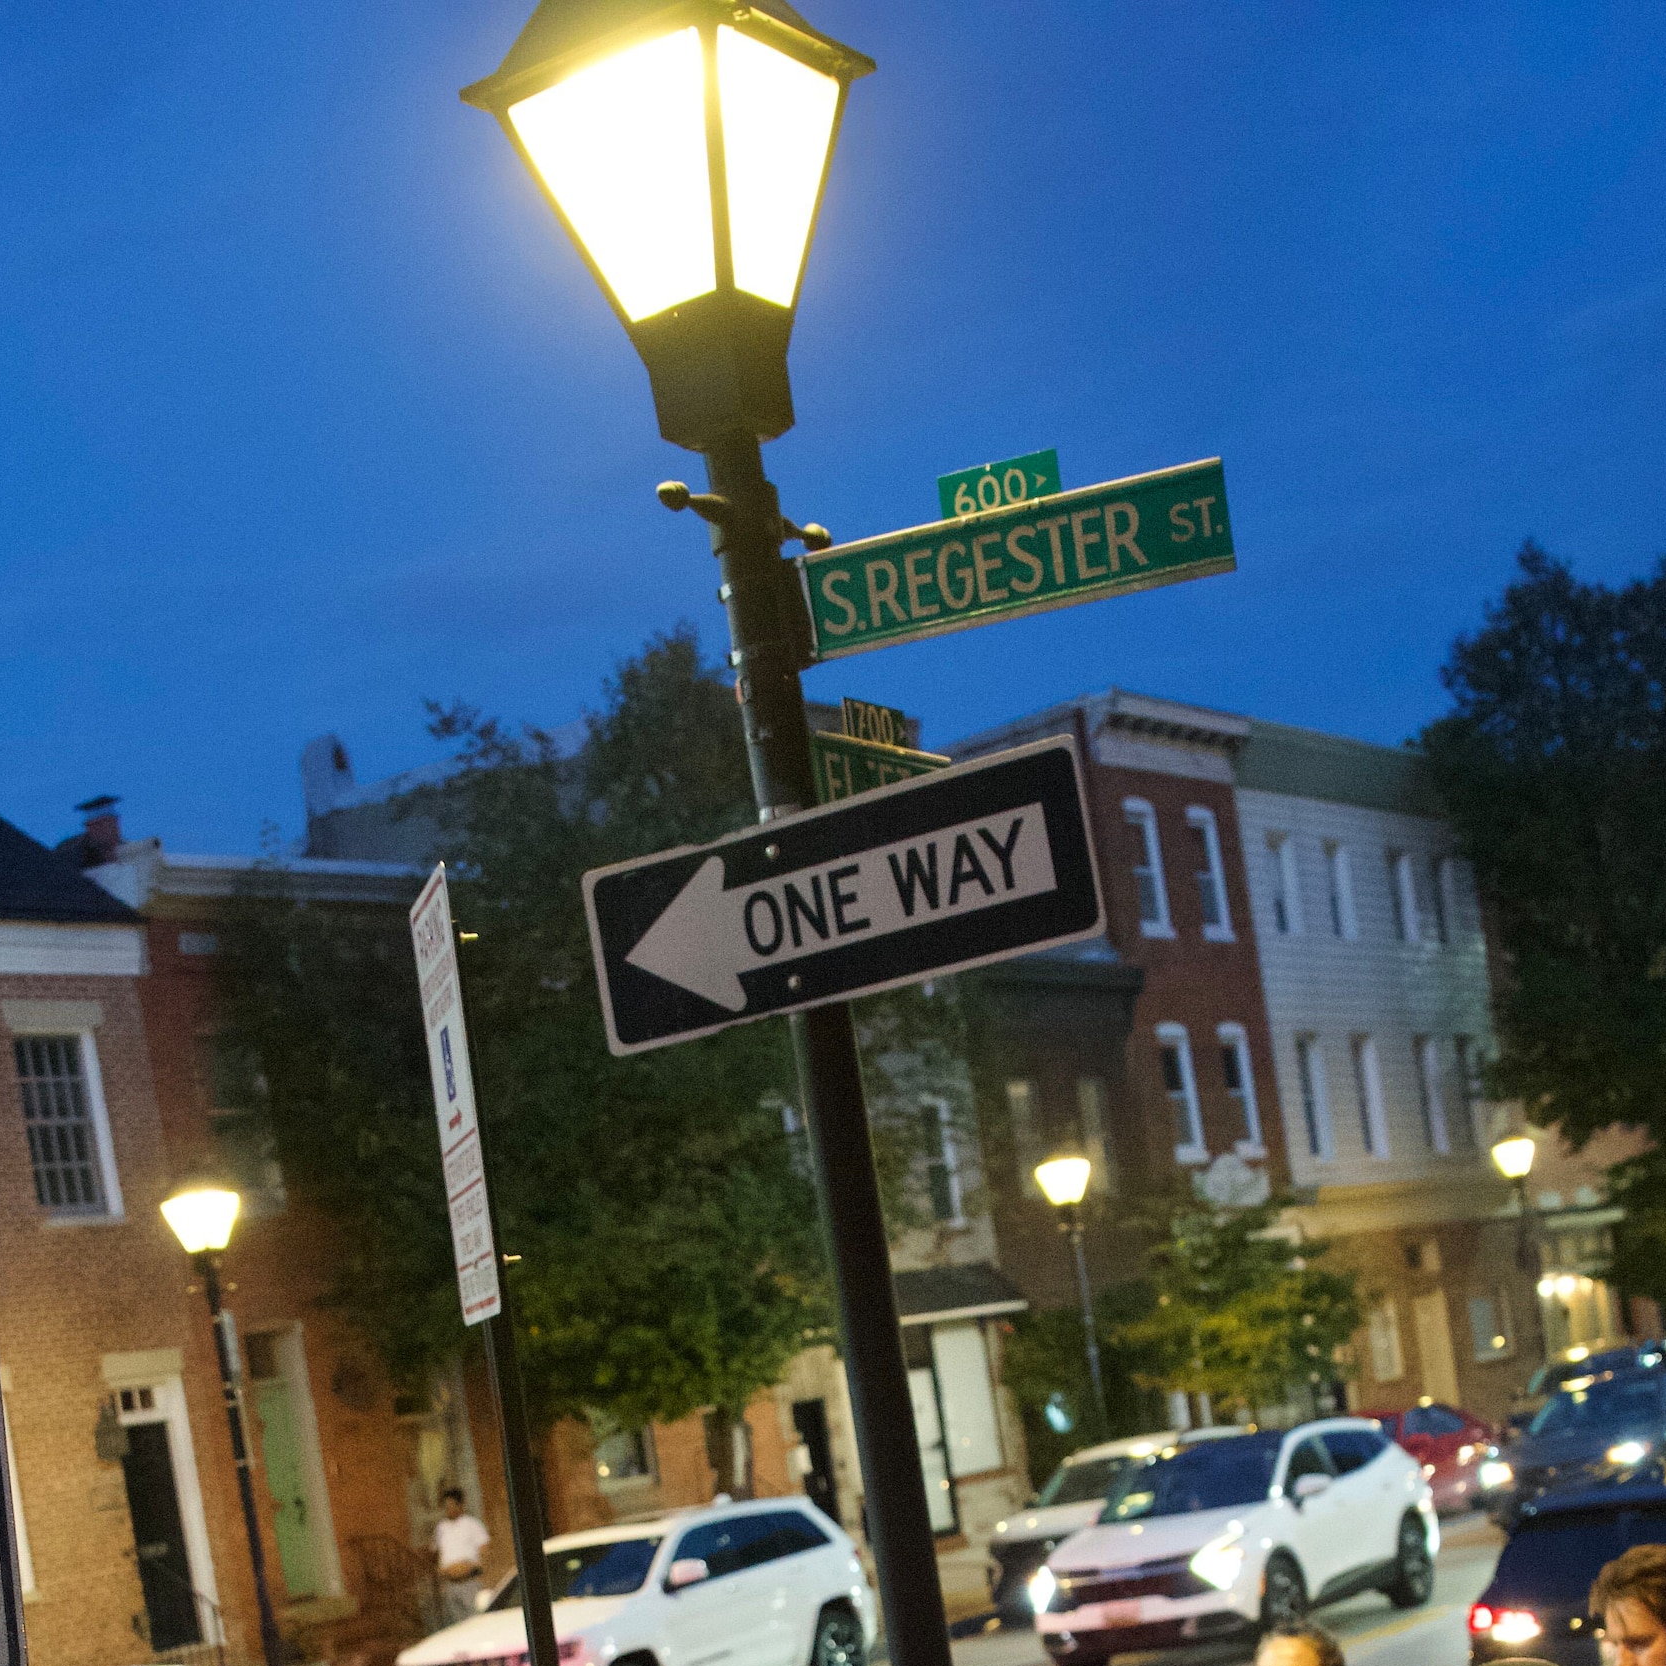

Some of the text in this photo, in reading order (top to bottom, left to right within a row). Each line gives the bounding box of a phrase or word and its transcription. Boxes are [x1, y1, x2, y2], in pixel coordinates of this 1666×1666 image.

[954, 467, 1028, 518] 600
[1169, 496, 1224, 543] ST.
[744, 816, 1024, 957] ONE WAY
